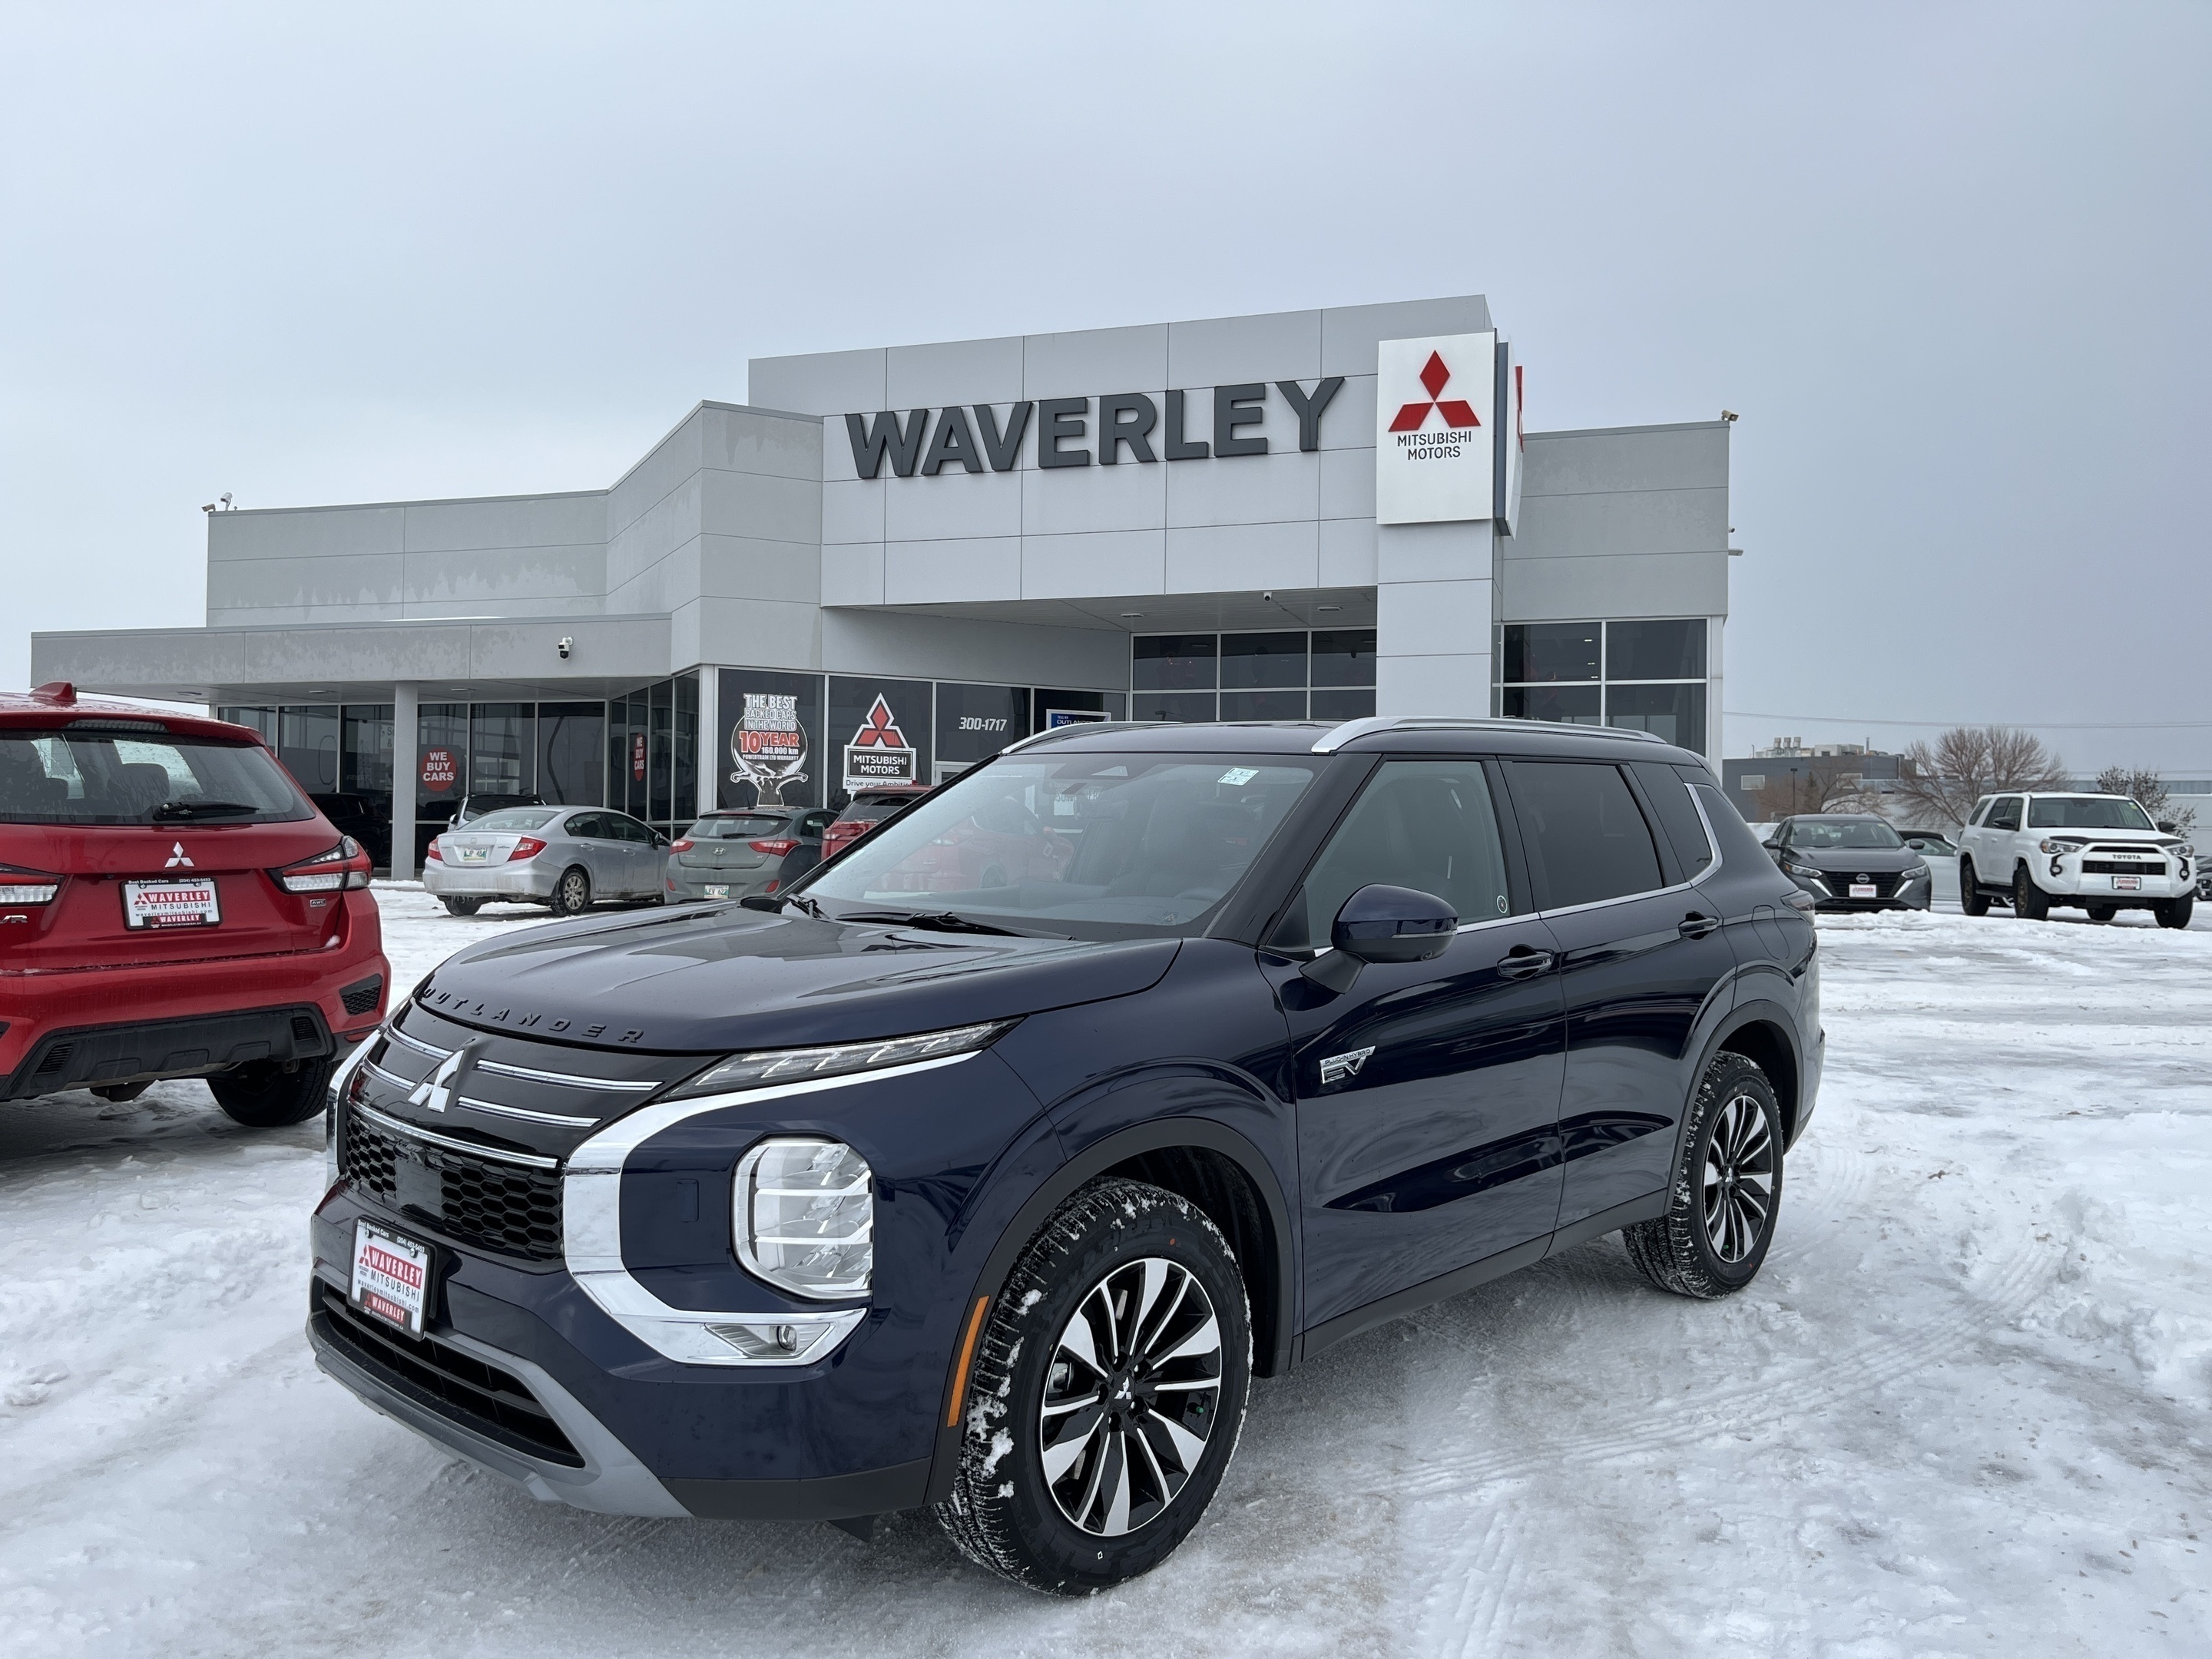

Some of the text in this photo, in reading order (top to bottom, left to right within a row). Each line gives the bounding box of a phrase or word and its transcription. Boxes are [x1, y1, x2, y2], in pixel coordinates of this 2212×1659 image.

[845, 376, 1344, 479] WAVERLEY
[1397, 431, 1472, 447] MITSUBISHI
[1408, 445, 1461, 460] MOTORS
[744, 694, 797, 710] THE BEST
[745, 708, 796, 720] BACKED CARS
[745, 720, 753, 729] IN
[753, 720, 768, 730] THE
[769, 720, 796, 731] WORLD
[959, 717, 1008, 731] 300-1717
[636, 737, 643, 747] WE
[739, 730, 800, 753] 10 YEAR
[429, 752, 448, 761] WE
[635, 749, 644, 759] BUY
[761, 747, 787, 755] 160,000
[426, 761, 451, 771] BUY
[634, 760, 644, 770] CARS
[853, 755, 907, 766] MITSUBISHI
[860, 765, 900, 775] MOTORS
[422, 772, 455, 782] CARS
[148, 892, 209, 902] WAVERLEY
[151, 902, 211, 910] MITSUBISHI
[135, 909, 213, 917] waverleymitsubishi.com
[159, 914, 200, 922] WAVERLEY
[422, 987, 644, 1044] OUTLANDER
[1349, 1048, 1371, 1058] HYBRD
[1320, 1055, 1367, 1084] EV
[366, 1223, 380, 1234] Backed
[379, 1228, 389, 1238] Cars
[371, 1248, 422, 1286] WAVERLEY
[371, 1270, 420, 1302] MITSUBISHI
[357, 1279, 419, 1313] waverleymitsubishi.com
[373, 1296, 406, 1322] WAVERLEY
